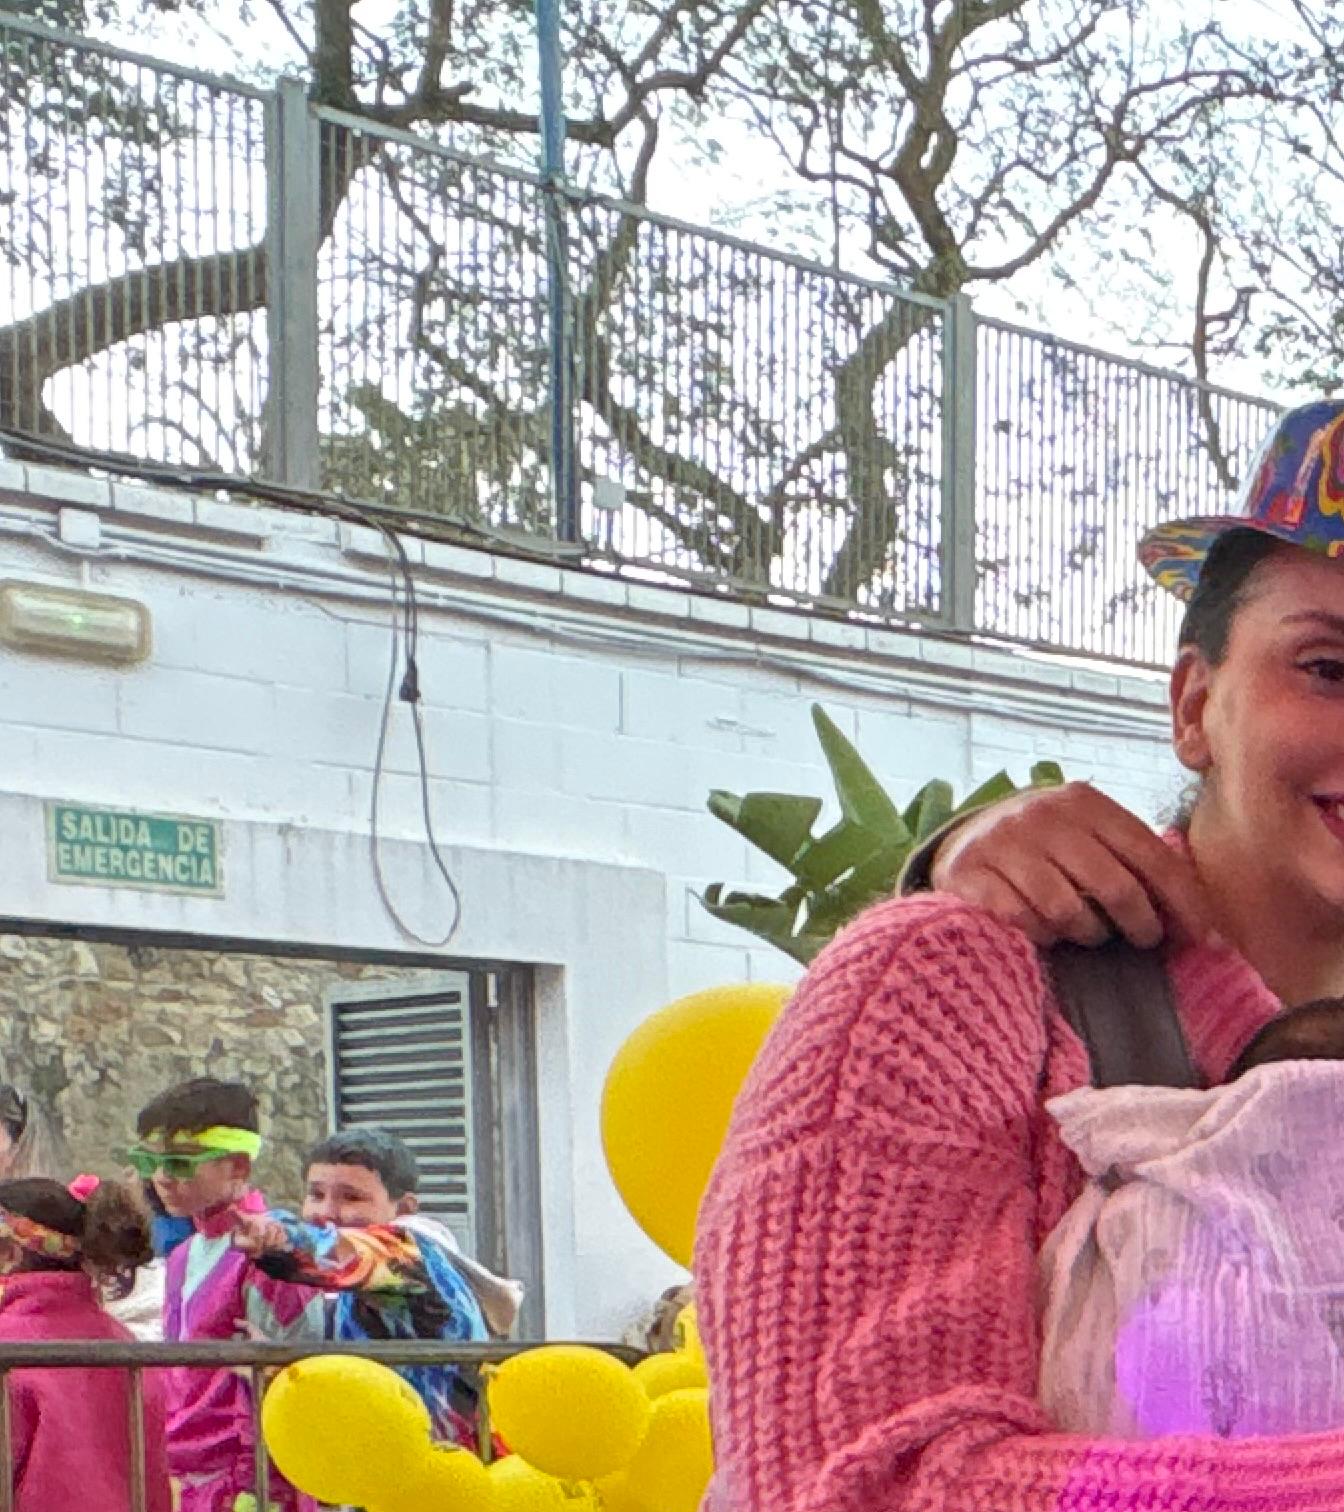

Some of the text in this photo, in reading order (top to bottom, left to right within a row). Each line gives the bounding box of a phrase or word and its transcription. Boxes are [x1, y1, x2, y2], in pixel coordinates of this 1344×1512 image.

[62, 810, 210, 854] SALIDA DE
[58, 841, 214, 884] EMERGENCIA
